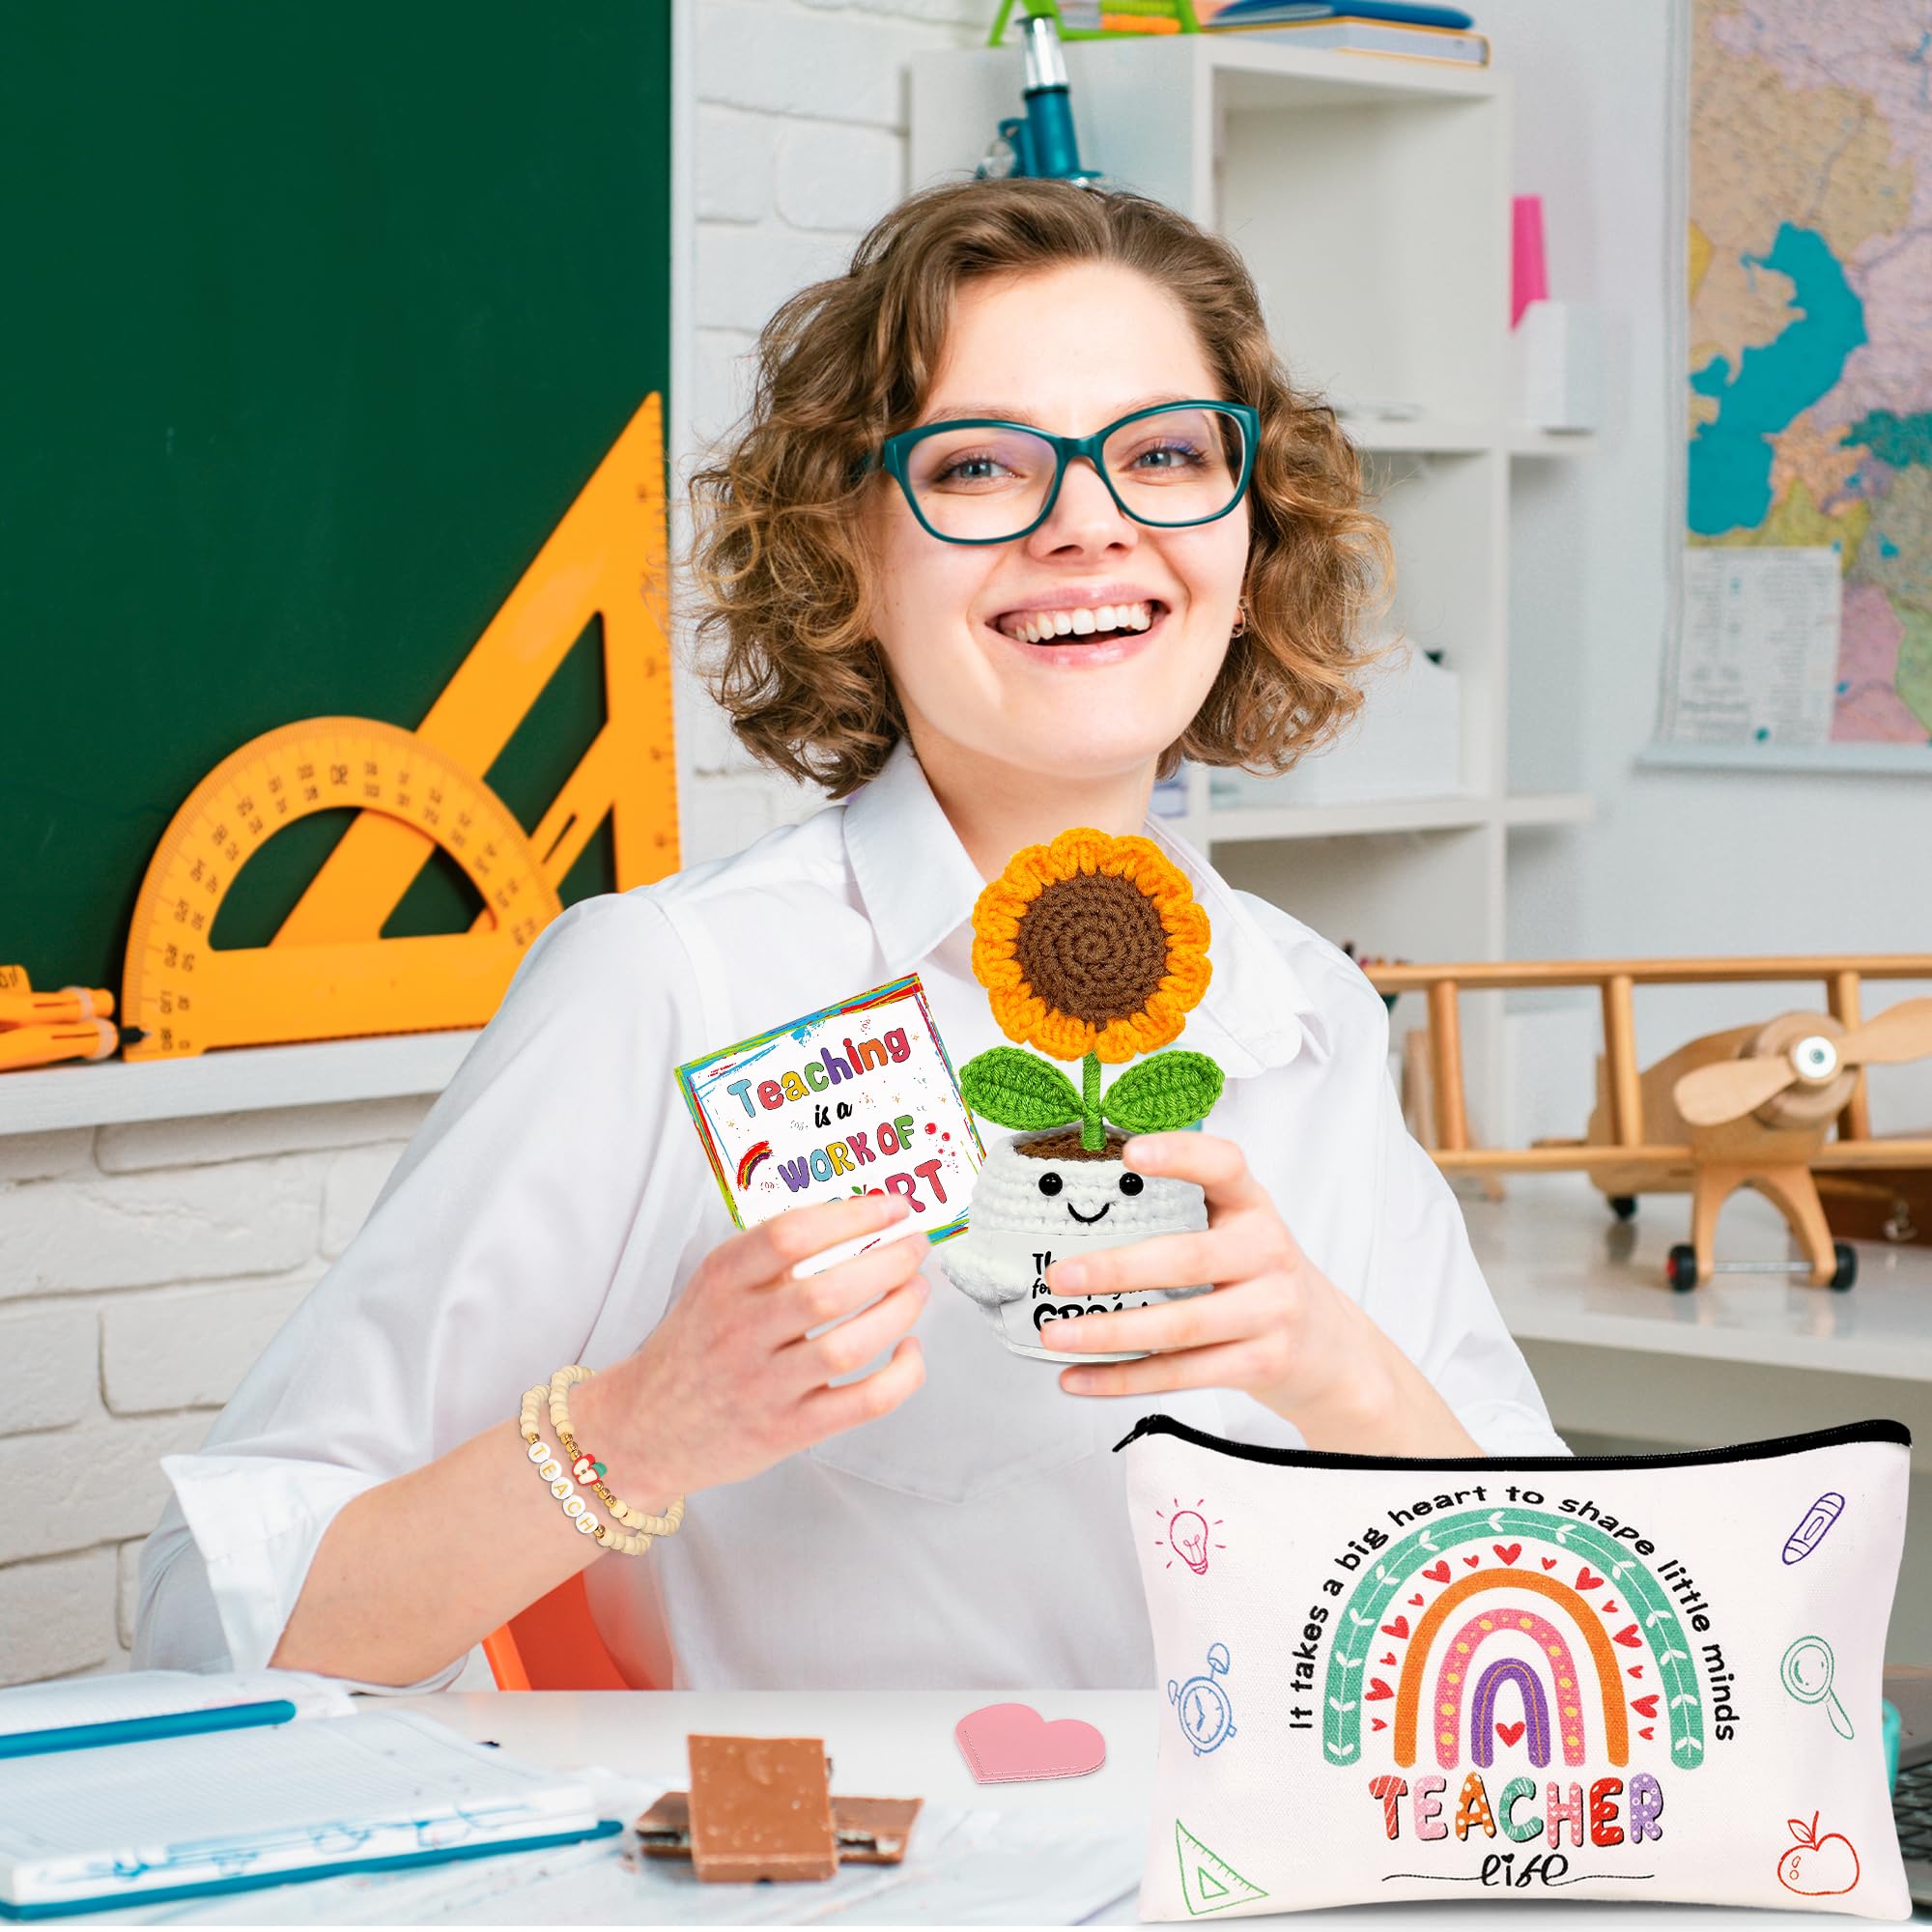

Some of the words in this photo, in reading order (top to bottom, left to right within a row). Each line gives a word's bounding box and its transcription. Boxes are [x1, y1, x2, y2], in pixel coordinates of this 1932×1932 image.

[726, 1027, 911, 1119] Teaching
[814, 1104, 832, 1128] is
[837, 1101, 853, 1120] a
[777, 1131, 876, 1193] WORK
[876, 1115, 915, 1156] OF
[532, 1444, 596, 1532] TEACH
[1387, 1486, 1488, 1527] heart
[1505, 1486, 1545, 1505] to
[1334, 1527, 1389, 1572] big
[1558, 1498, 1655, 1556] shape
[1322, 1578, 1345, 1597] a
[1657, 1559, 1711, 1633] little
[1290, 1605, 1329, 1692] takes
[1289, 1706, 1313, 1729] It
[1701, 1643, 1741, 1741] minds
[1368, 1771, 1664, 1850] TEACHER
